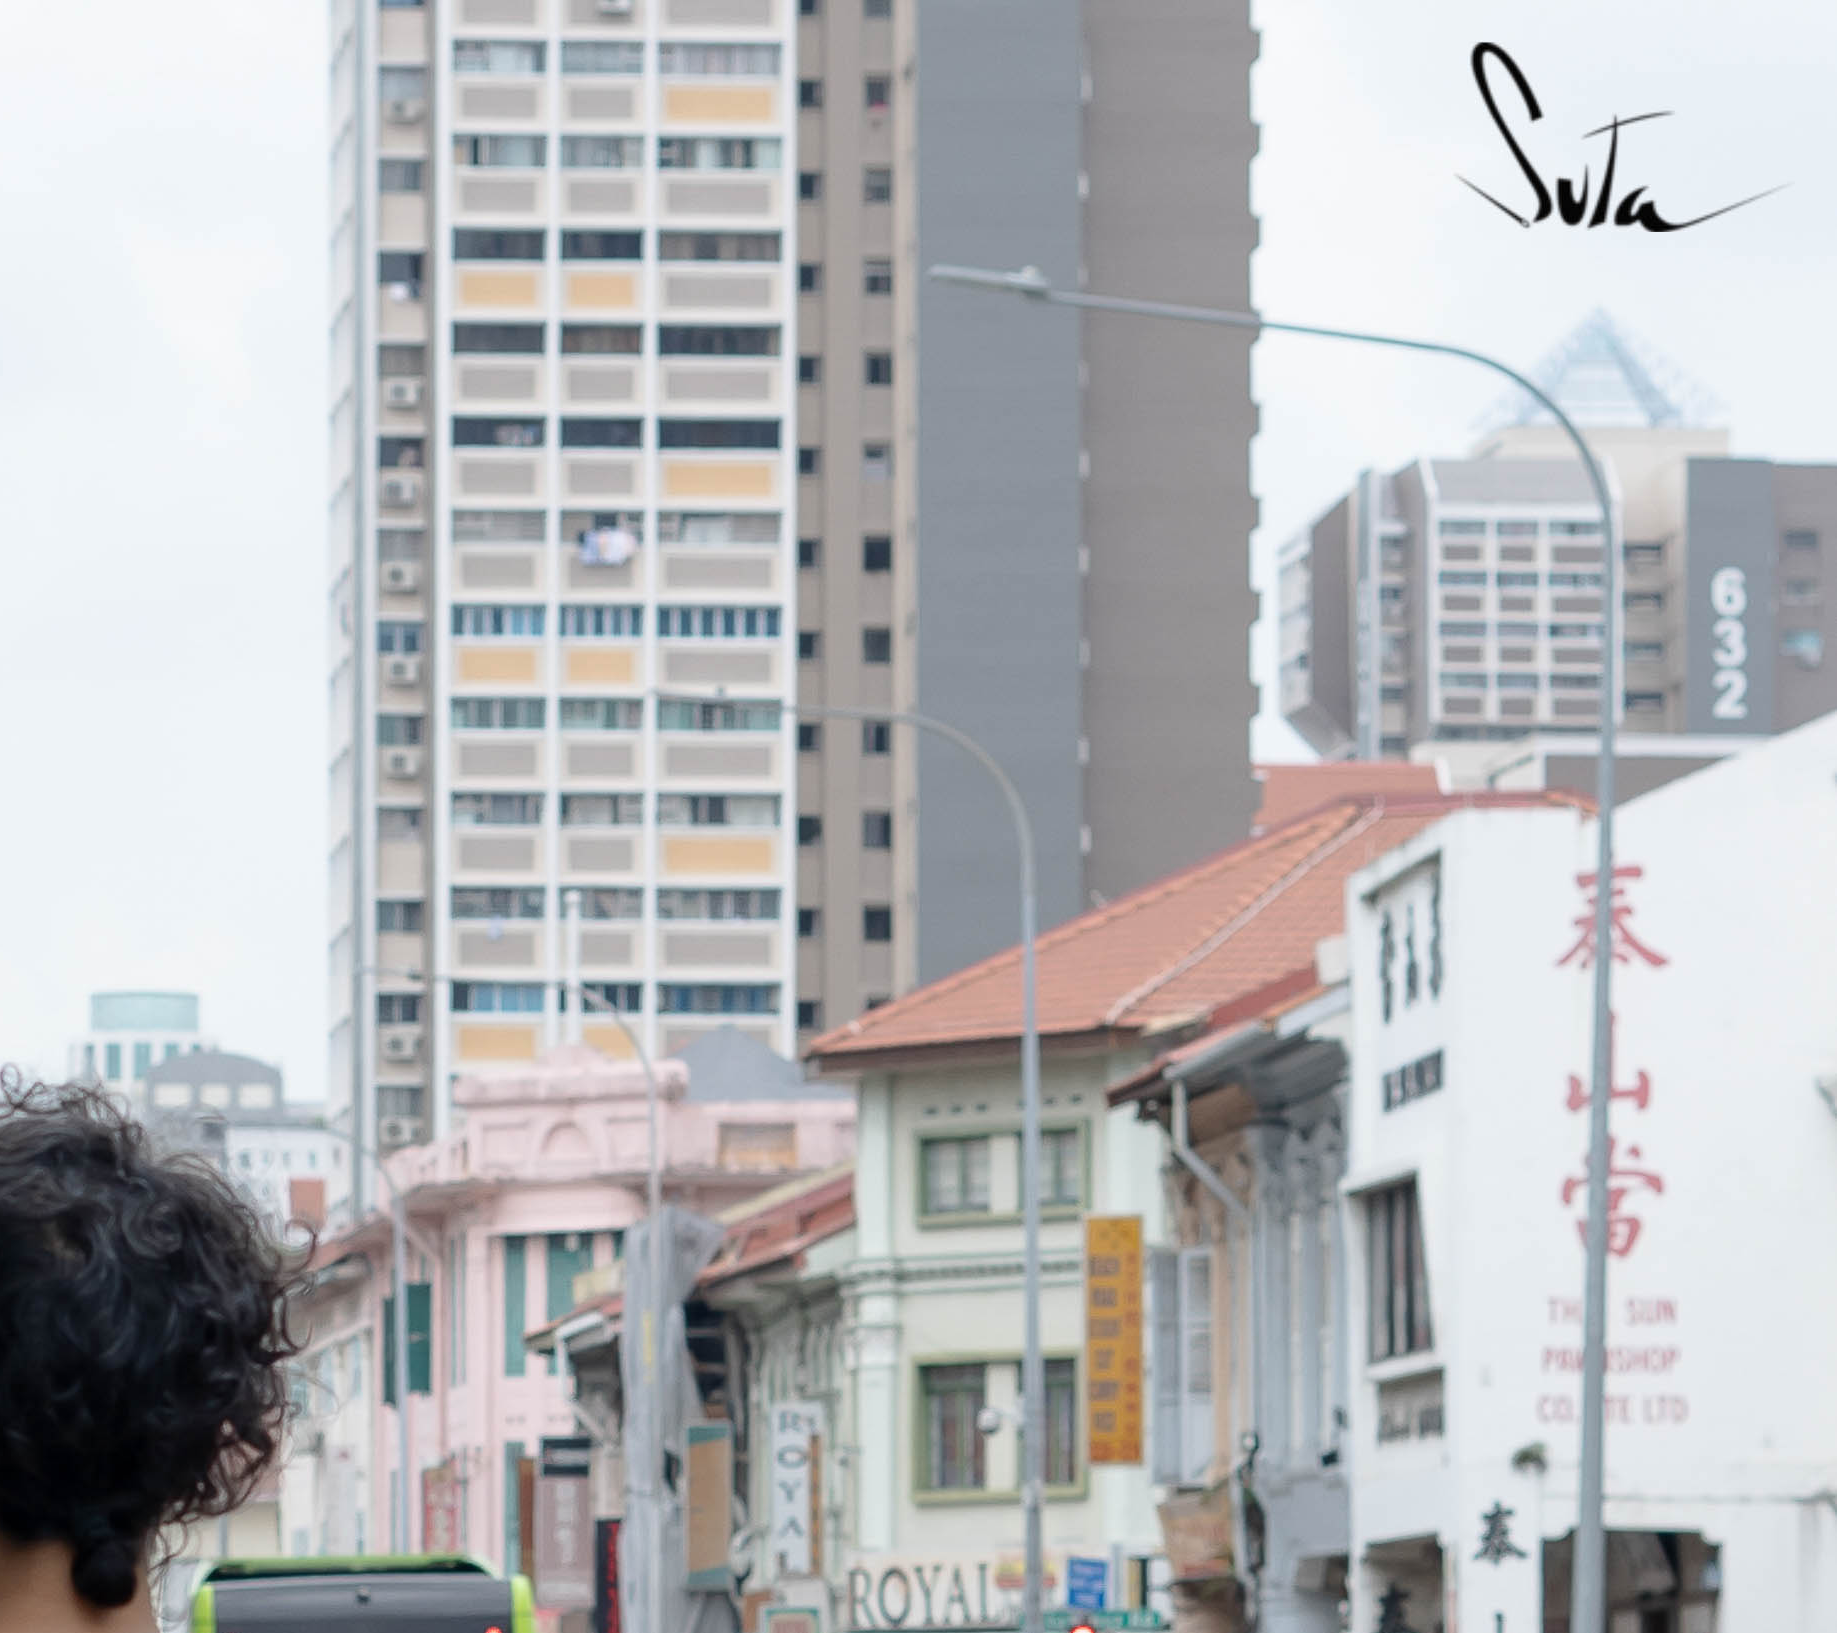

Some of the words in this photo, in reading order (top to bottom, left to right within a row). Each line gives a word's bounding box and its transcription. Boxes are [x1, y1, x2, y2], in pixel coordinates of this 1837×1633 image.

[1711, 566, 1747, 719] 632
[1626, 1297, 1677, 1326] SUN
[1643, 1395, 1689, 1424] LTD
[848, 1563, 1002, 1628] ROYAL
